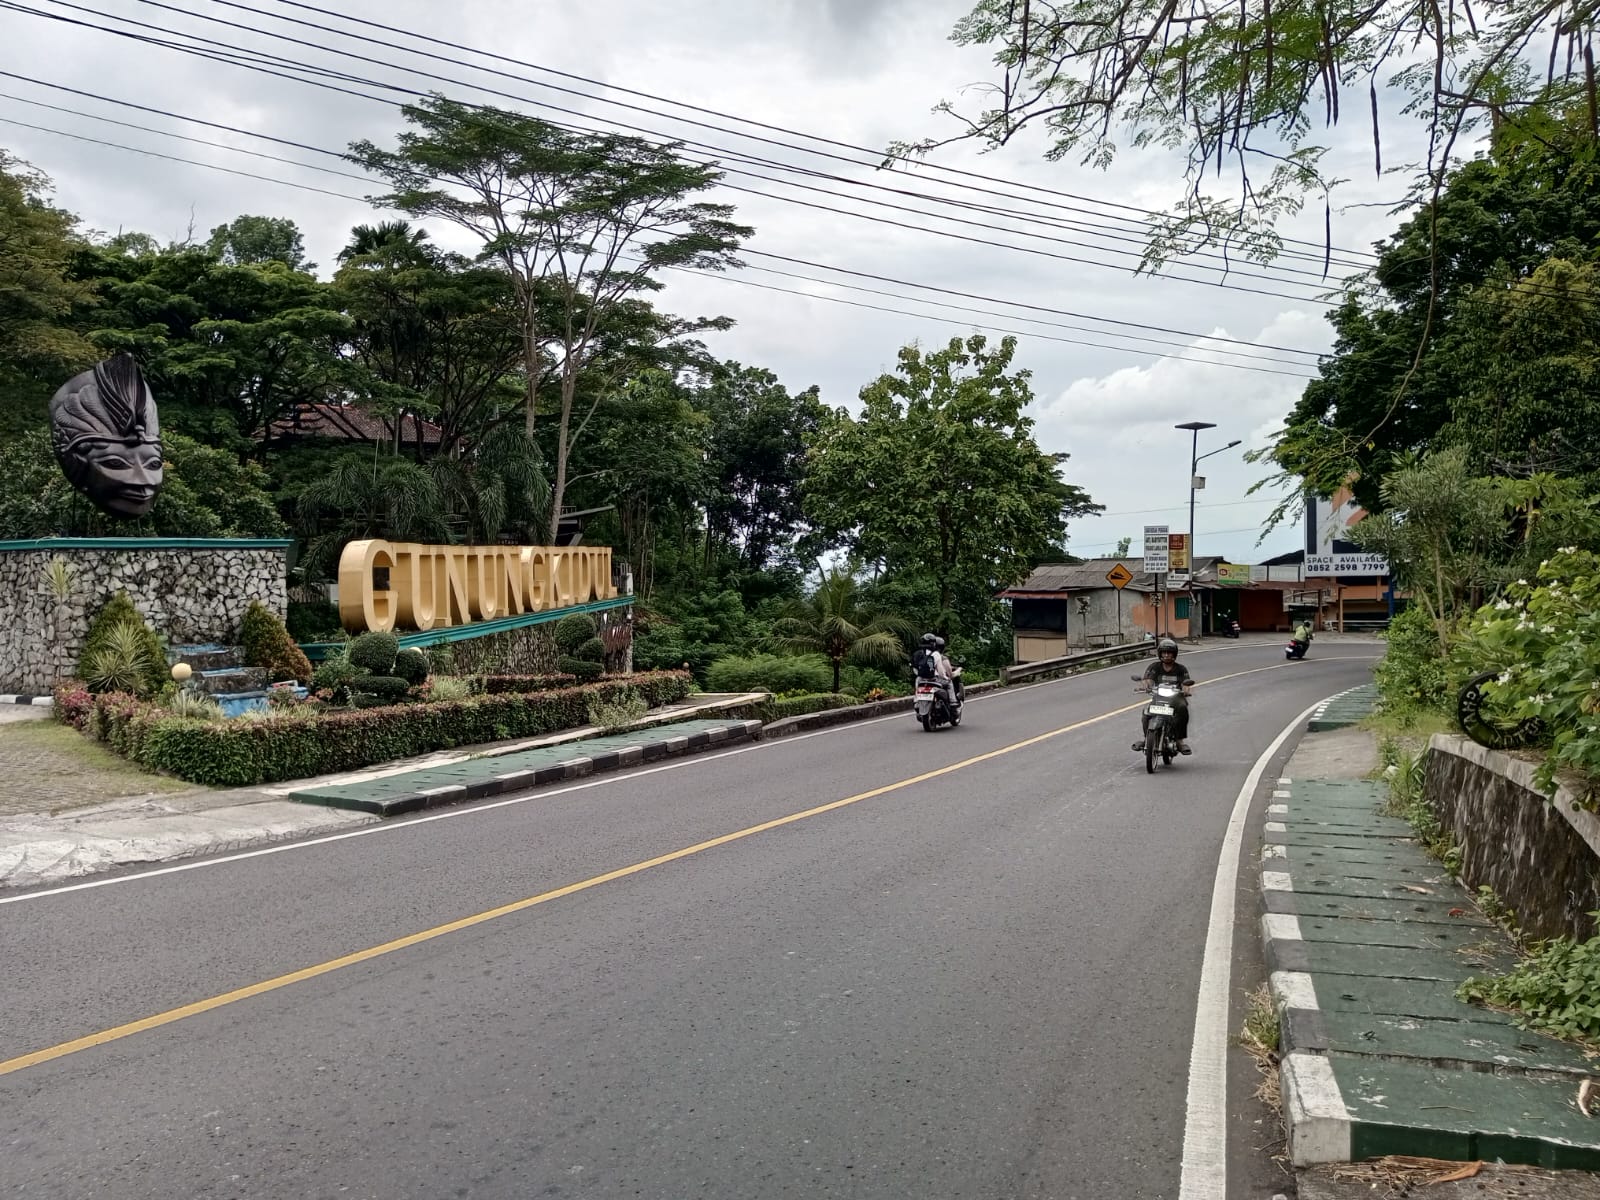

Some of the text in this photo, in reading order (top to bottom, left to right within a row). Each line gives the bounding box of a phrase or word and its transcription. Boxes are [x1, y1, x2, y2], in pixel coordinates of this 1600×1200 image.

[338, 539, 618, 632] GUNUNGKIDUL
[1307, 563, 1384, 572] 0852 2598 7799
